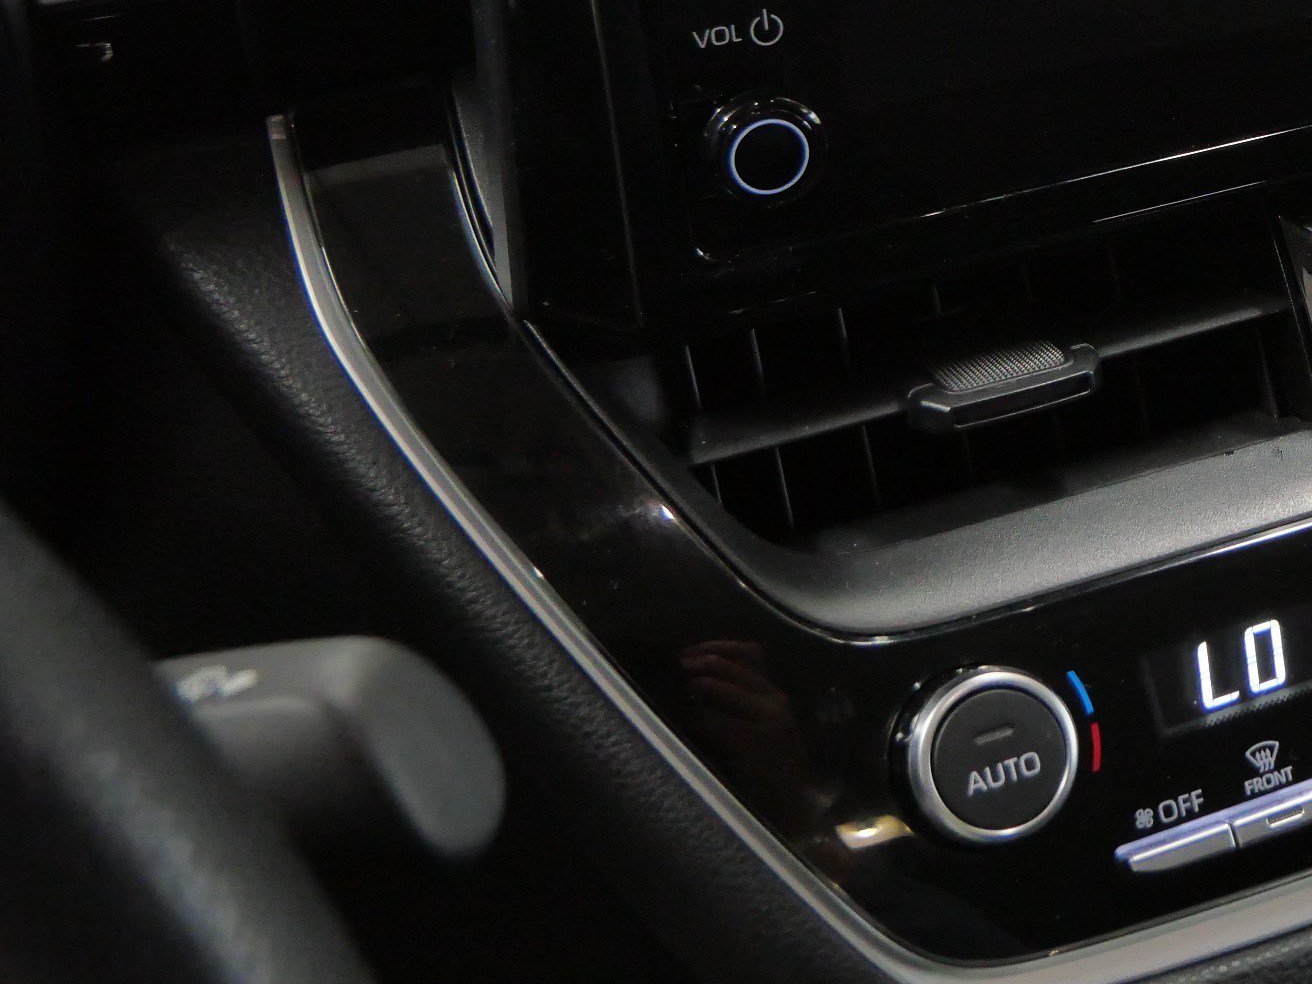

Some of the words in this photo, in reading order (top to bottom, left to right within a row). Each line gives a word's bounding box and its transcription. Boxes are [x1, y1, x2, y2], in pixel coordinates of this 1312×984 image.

[691, 24, 743, 49] VOL
[1197, 618, 1286, 709] LO
[967, 751, 1041, 797] AUTO
[1244, 765, 1294, 796] FRONT
[1157, 789, 1204, 824] OFF
